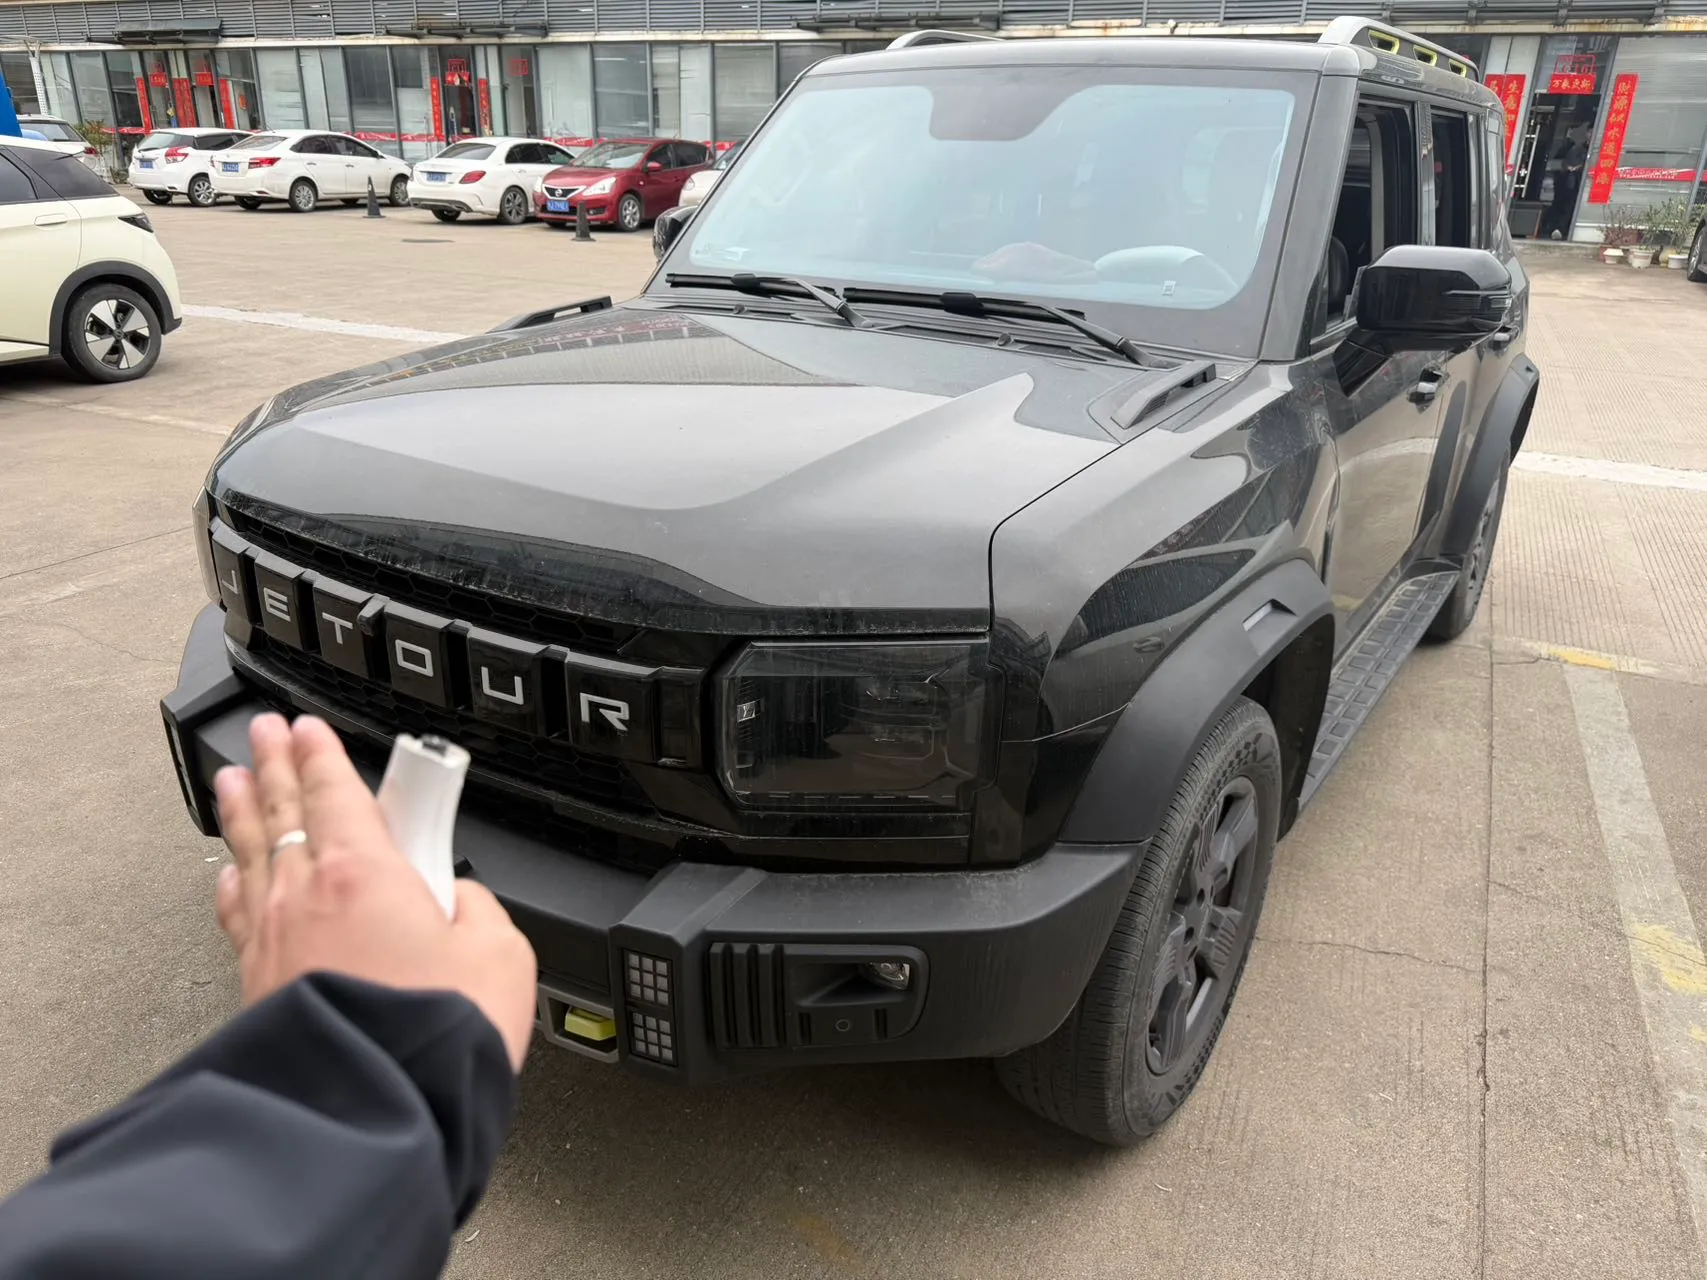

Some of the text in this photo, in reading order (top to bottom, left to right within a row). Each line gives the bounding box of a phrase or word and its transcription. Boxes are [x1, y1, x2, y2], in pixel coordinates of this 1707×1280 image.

[1552, 77, 1591, 90] 万象更新
[221, 568, 631, 732] JETOUR
